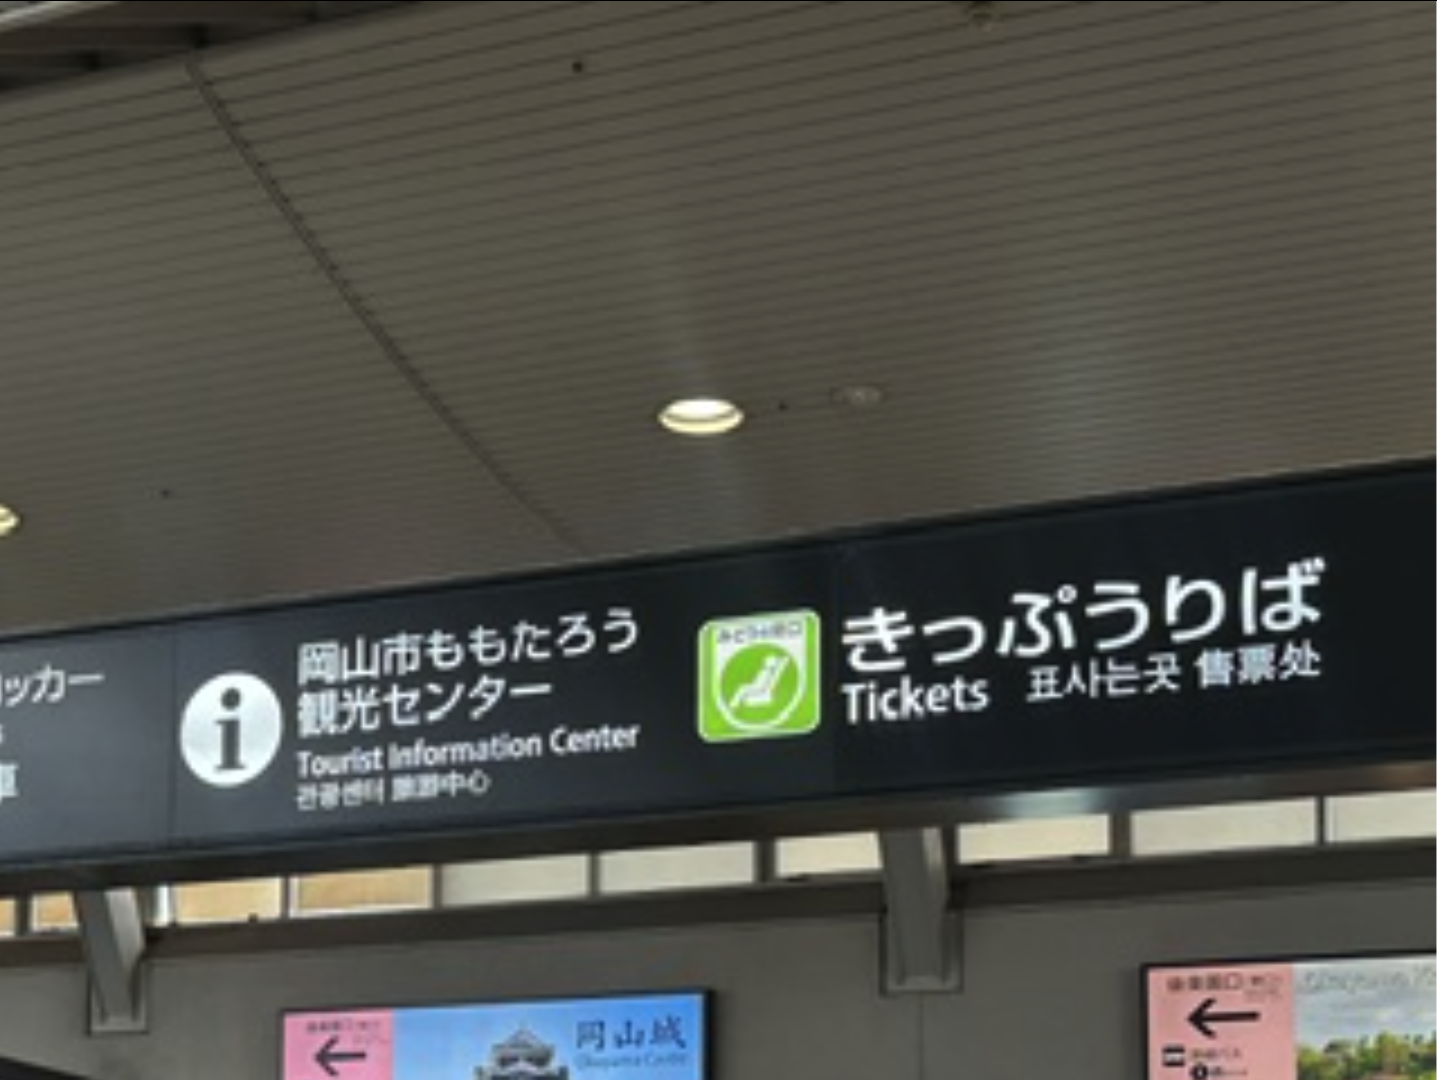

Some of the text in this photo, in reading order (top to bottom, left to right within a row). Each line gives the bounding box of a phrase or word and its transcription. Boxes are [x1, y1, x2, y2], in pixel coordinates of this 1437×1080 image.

[841, 557, 1326, 673] きっぷうりば
[297, 607, 640, 685] 岡山市ももたろう
[1193, 641, 1321, 689] 售票处
[842, 676, 990, 724] Tickets
[1026, 651, 1181, 702] 표사는곳
[298, 673, 553, 738] 観光センター
[297, 724, 641, 779] Tourist Information Center
